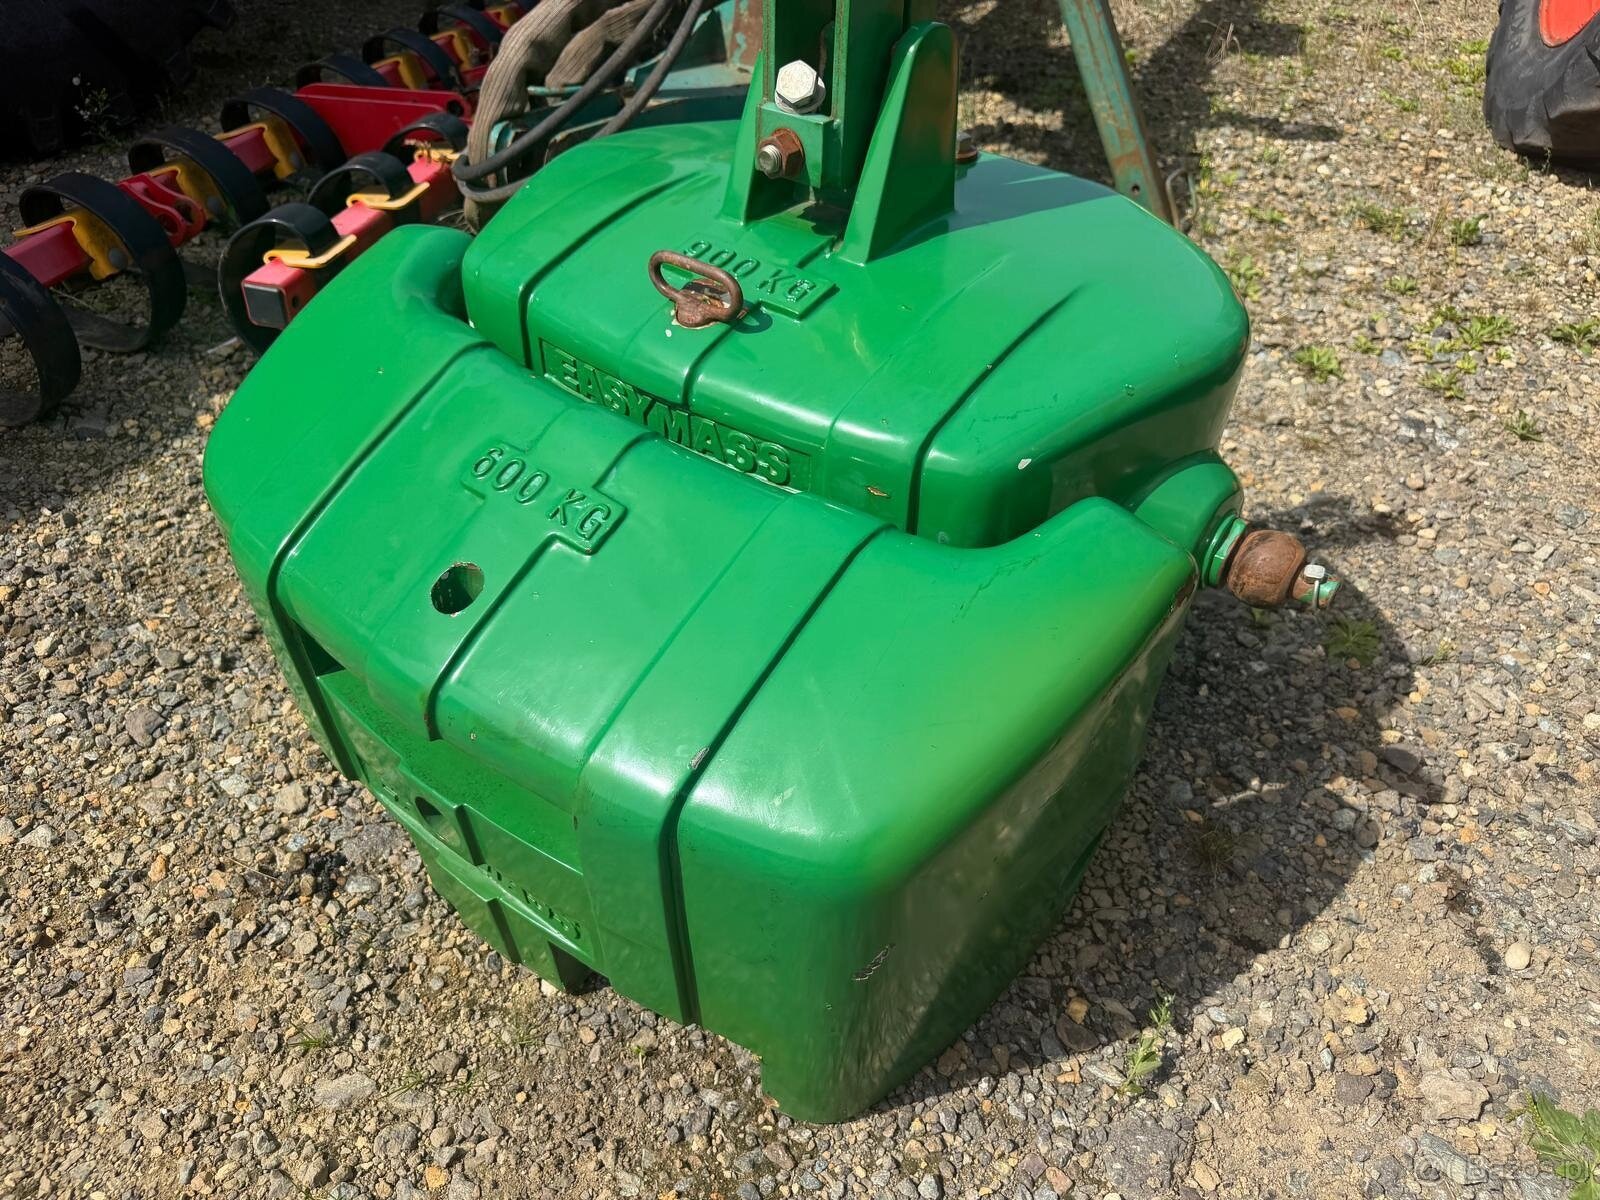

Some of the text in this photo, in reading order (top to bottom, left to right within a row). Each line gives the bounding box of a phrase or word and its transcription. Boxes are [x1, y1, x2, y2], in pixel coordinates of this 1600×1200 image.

[684, 240, 817, 302] 900 KG
[553, 348, 792, 487] EASYMASS
[471, 447, 612, 541] 600 KG
